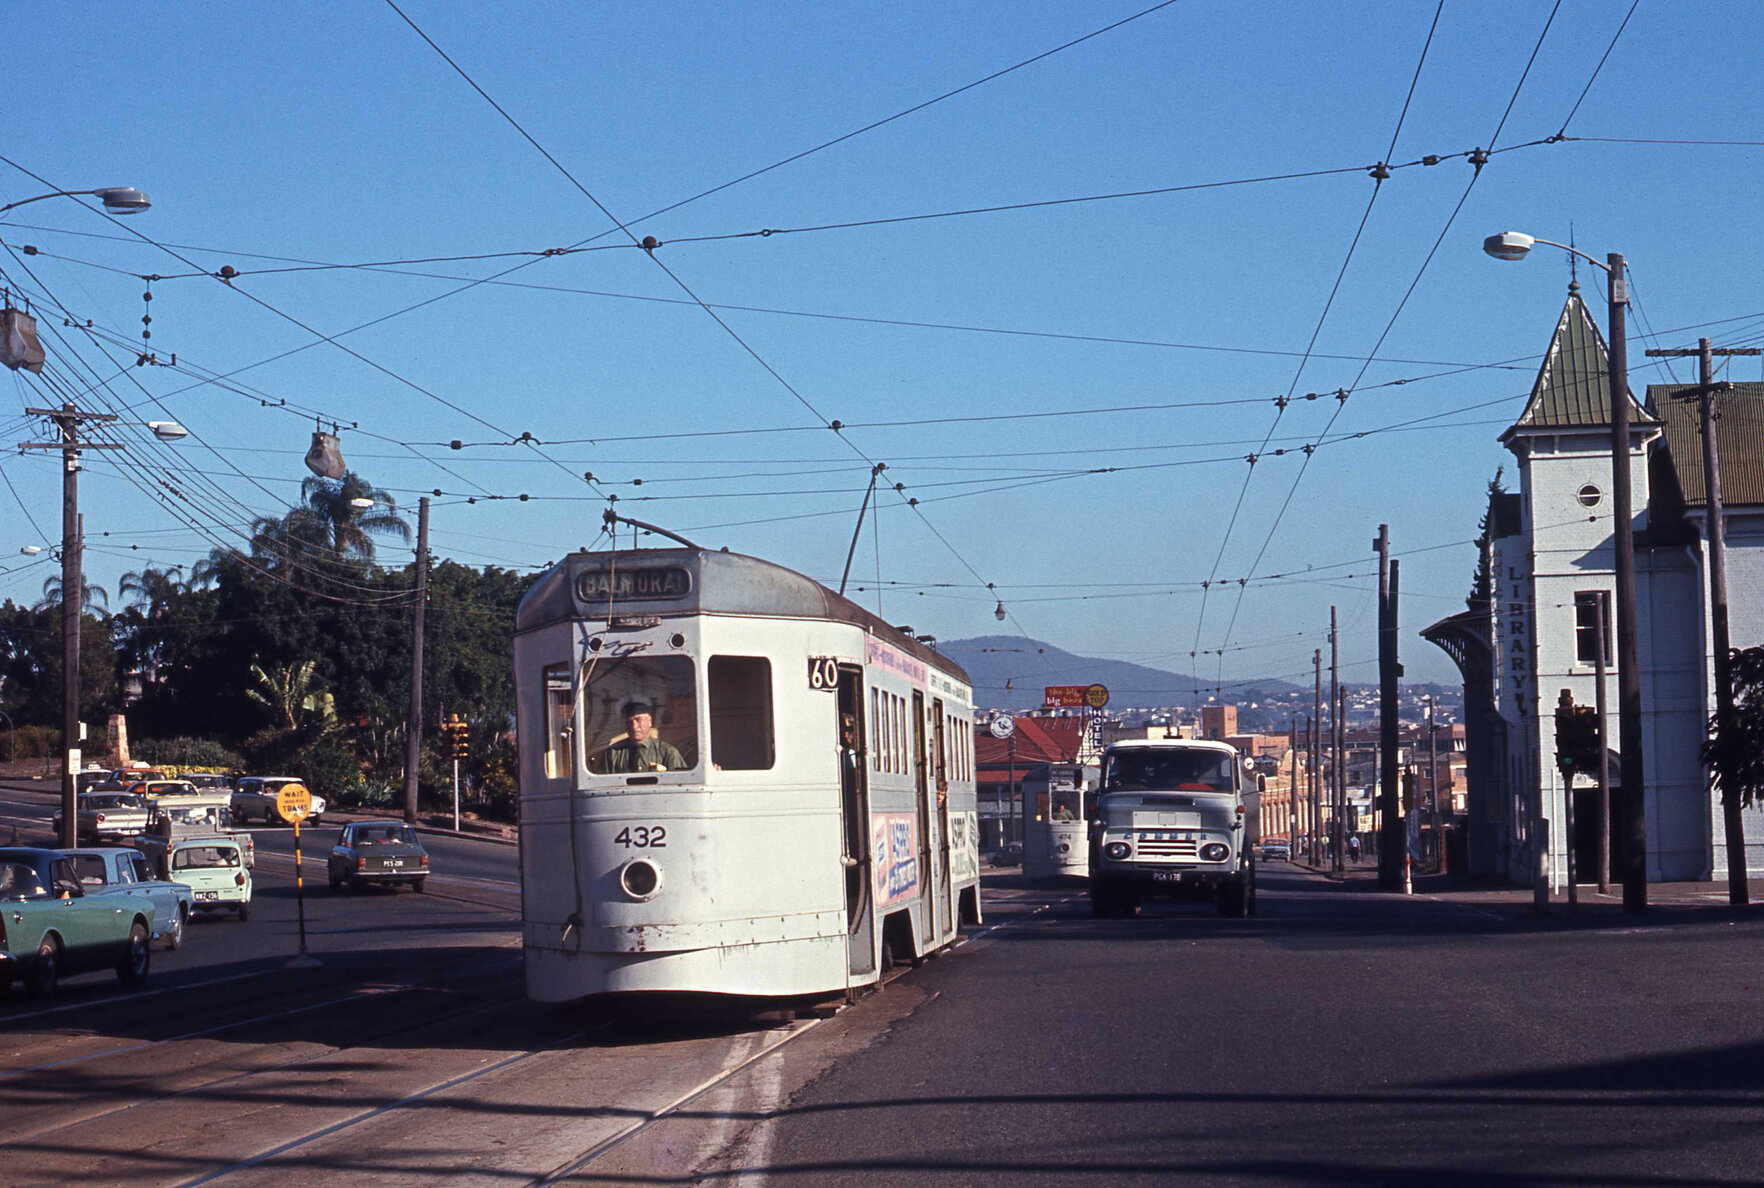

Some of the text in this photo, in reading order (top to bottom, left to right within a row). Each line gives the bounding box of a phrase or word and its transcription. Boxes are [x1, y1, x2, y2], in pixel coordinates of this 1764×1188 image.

[1508, 566, 1526, 689] LIBRARY
[812, 659, 838, 689] 60
[1046, 696, 1061, 706] big
[1093, 709, 1102, 747] HOTEL
[284, 790, 304, 798] WAIT
[614, 825, 667, 849] 432
